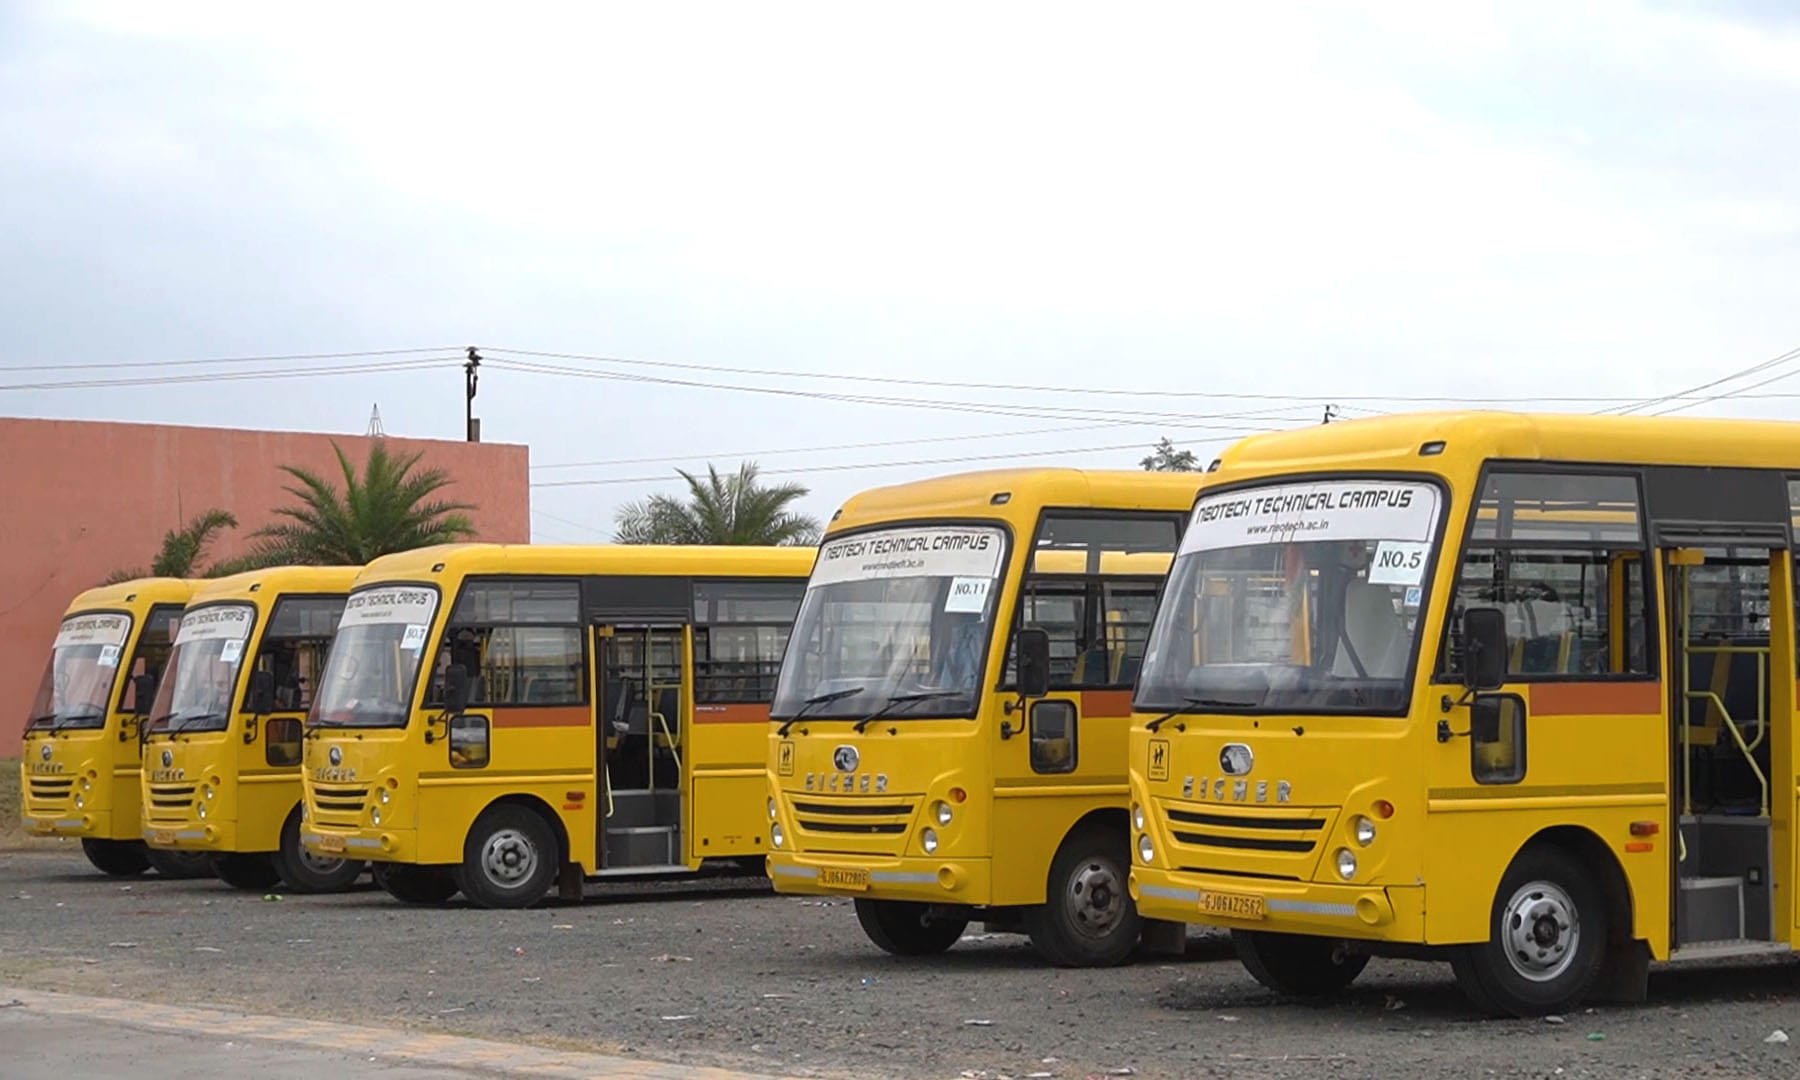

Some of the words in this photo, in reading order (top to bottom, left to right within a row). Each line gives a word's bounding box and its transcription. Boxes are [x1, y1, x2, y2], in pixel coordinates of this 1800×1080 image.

[1196, 500, 1250, 524] NEOTECH
[1255, 492, 1336, 514] TECHNICAL
[1338, 490, 1414, 508] CAMPUS
[1247, 519, 1330, 535] www.neotech.ac.in
[868, 536, 930, 555] TECHNICAL
[932, 535, 990, 550] CAMPUS
[1378, 551, 1423, 569] NO.5
[954, 583, 986, 595] NO.11
[805, 772, 889, 793] EICHER
[1183, 775, 1293, 803] EICHER
[1205, 893, 1262, 915] GJ06AZ2562
